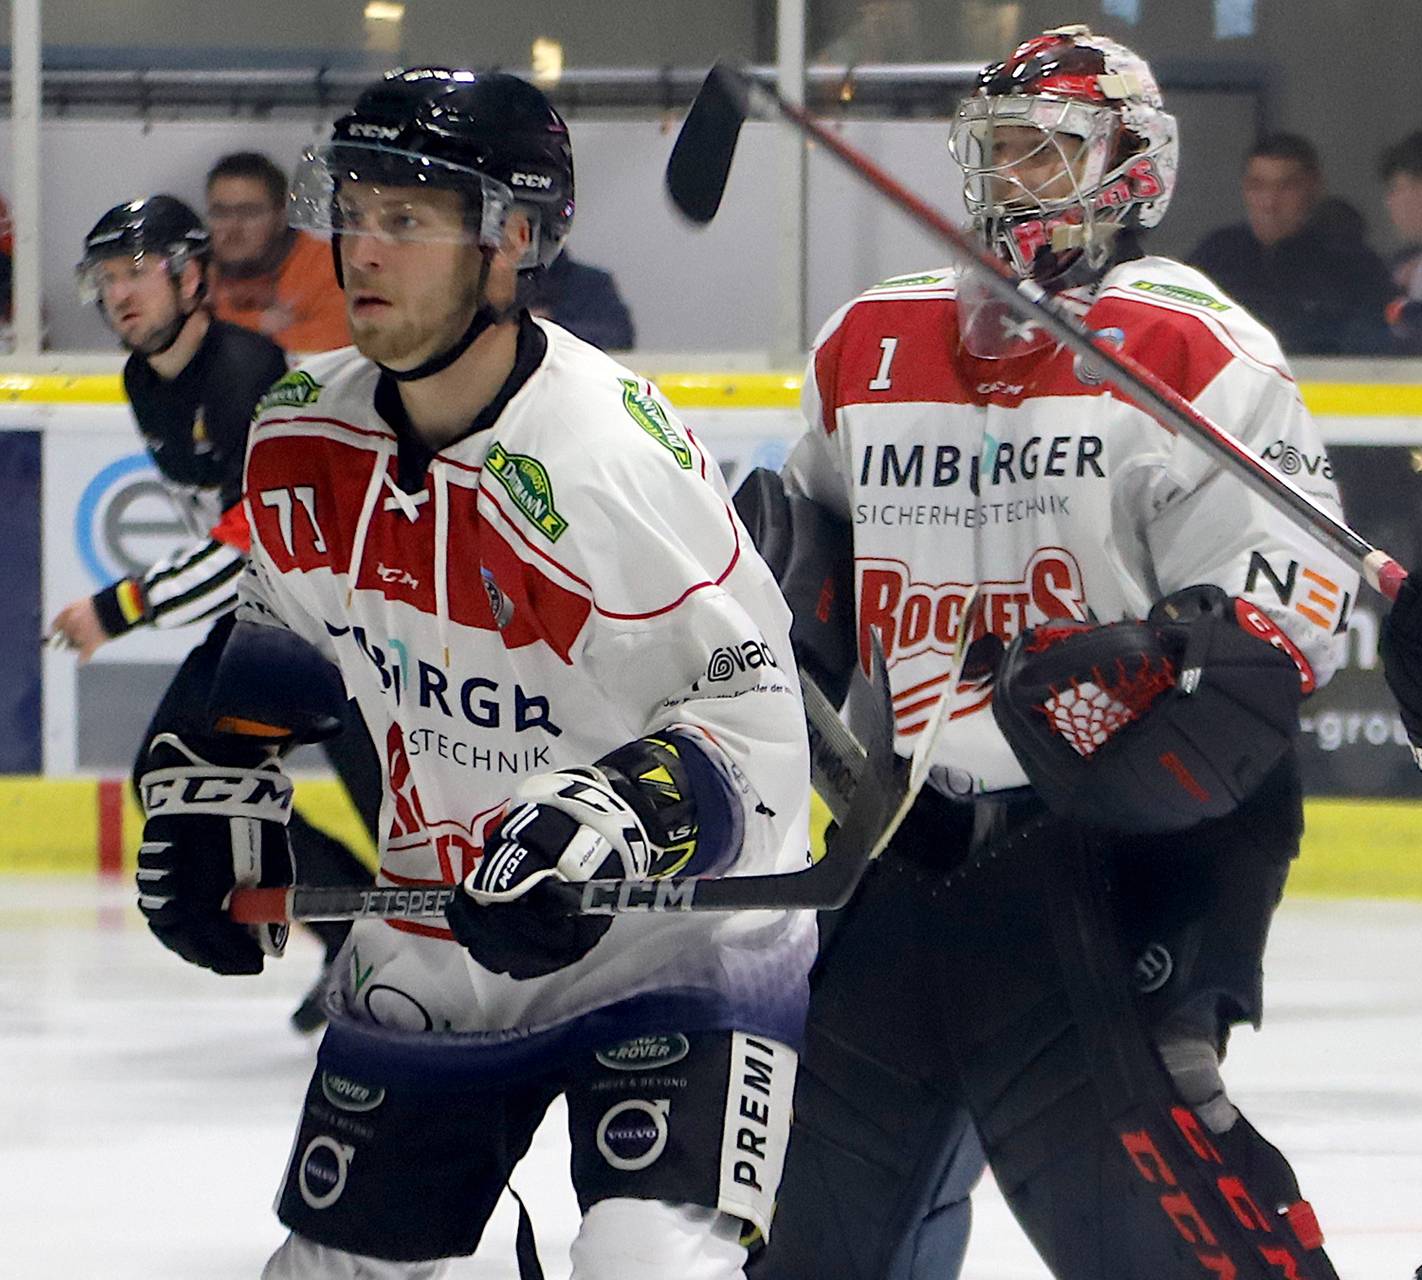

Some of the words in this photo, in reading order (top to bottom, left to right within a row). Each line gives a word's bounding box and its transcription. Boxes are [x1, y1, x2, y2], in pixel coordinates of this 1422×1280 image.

[348, 123, 400, 141] CCM
[511, 171, 553, 190] CCM
[867, 336, 898, 391] 1
[860, 558, 1086, 681] ROCETS
[146, 774, 293, 811] CCM
[497, 847, 529, 890] CCM
[354, 887, 456, 918] JETSPEE
[580, 877, 699, 914] CCM
[616, 1043, 671, 1060] ROVER
[639, 1076, 688, 1089] BEYOND
[733, 1037, 775, 1193] PREMI
[606, 1128, 658, 1141] VOLVO
